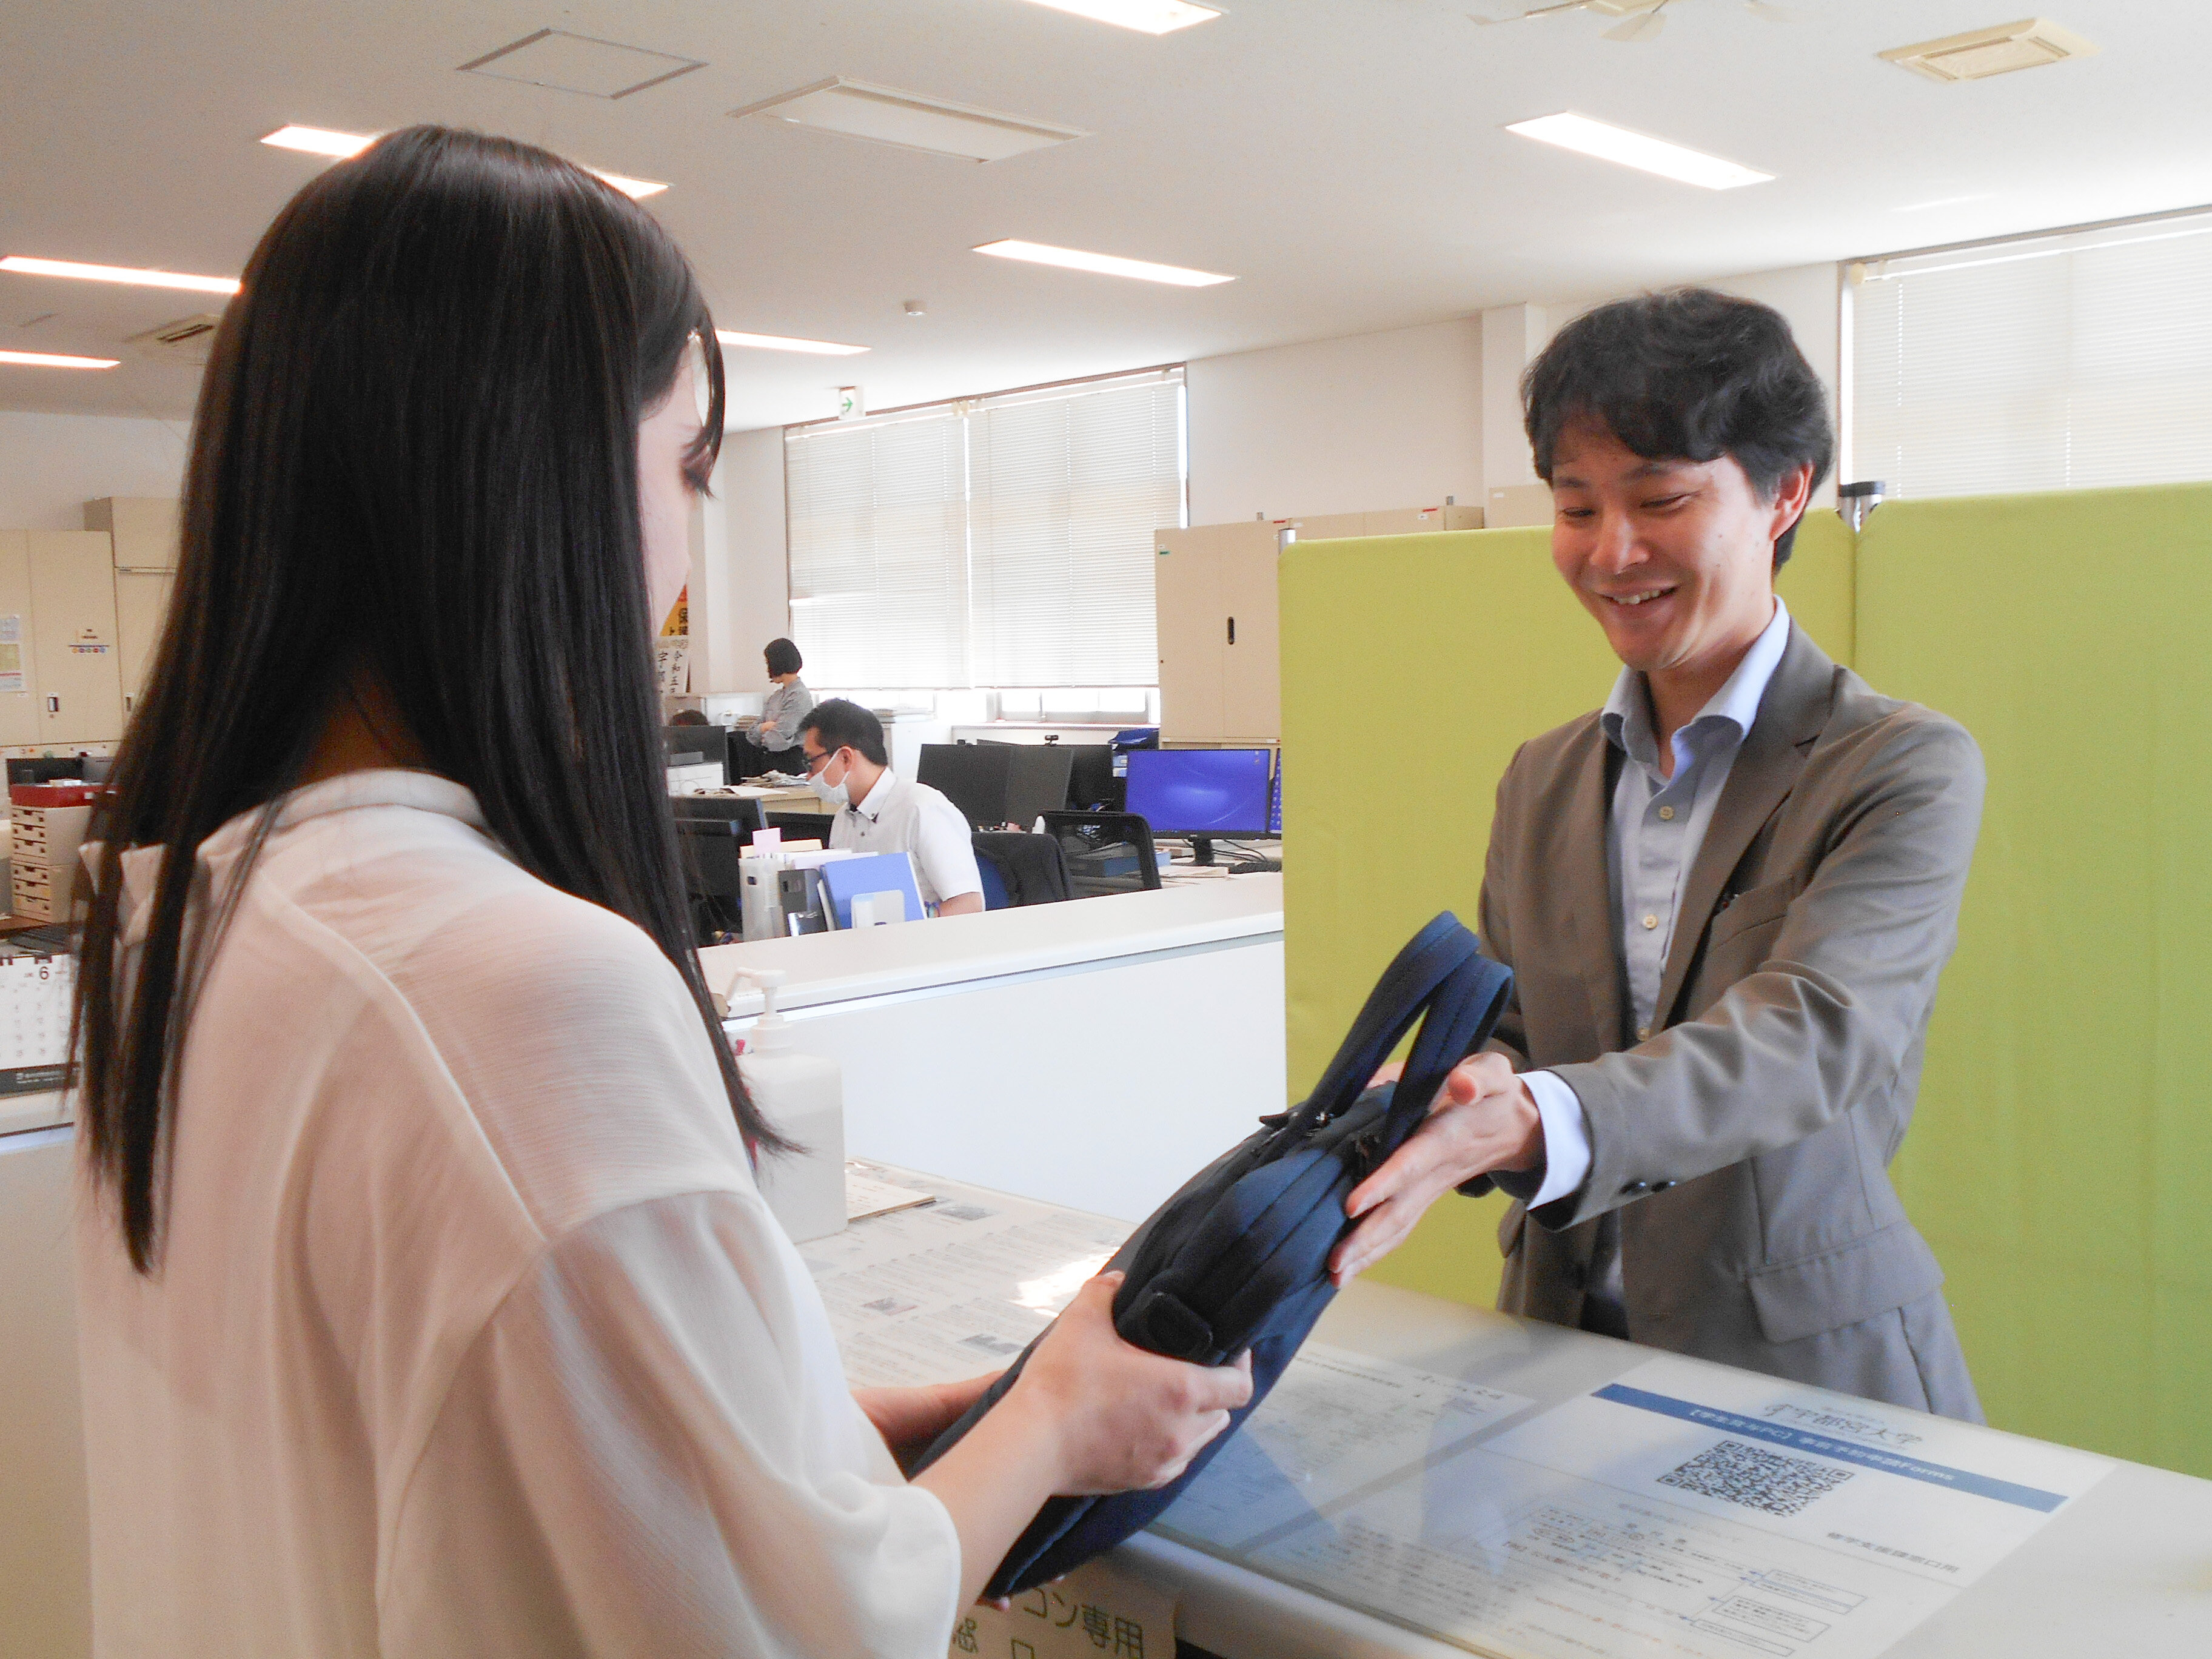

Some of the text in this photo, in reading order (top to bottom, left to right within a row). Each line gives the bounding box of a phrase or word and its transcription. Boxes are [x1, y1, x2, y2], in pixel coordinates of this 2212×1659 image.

[40, 967, 49, 979] 6
[1791, 1408, 1922, 1444] 宇都宮大学
